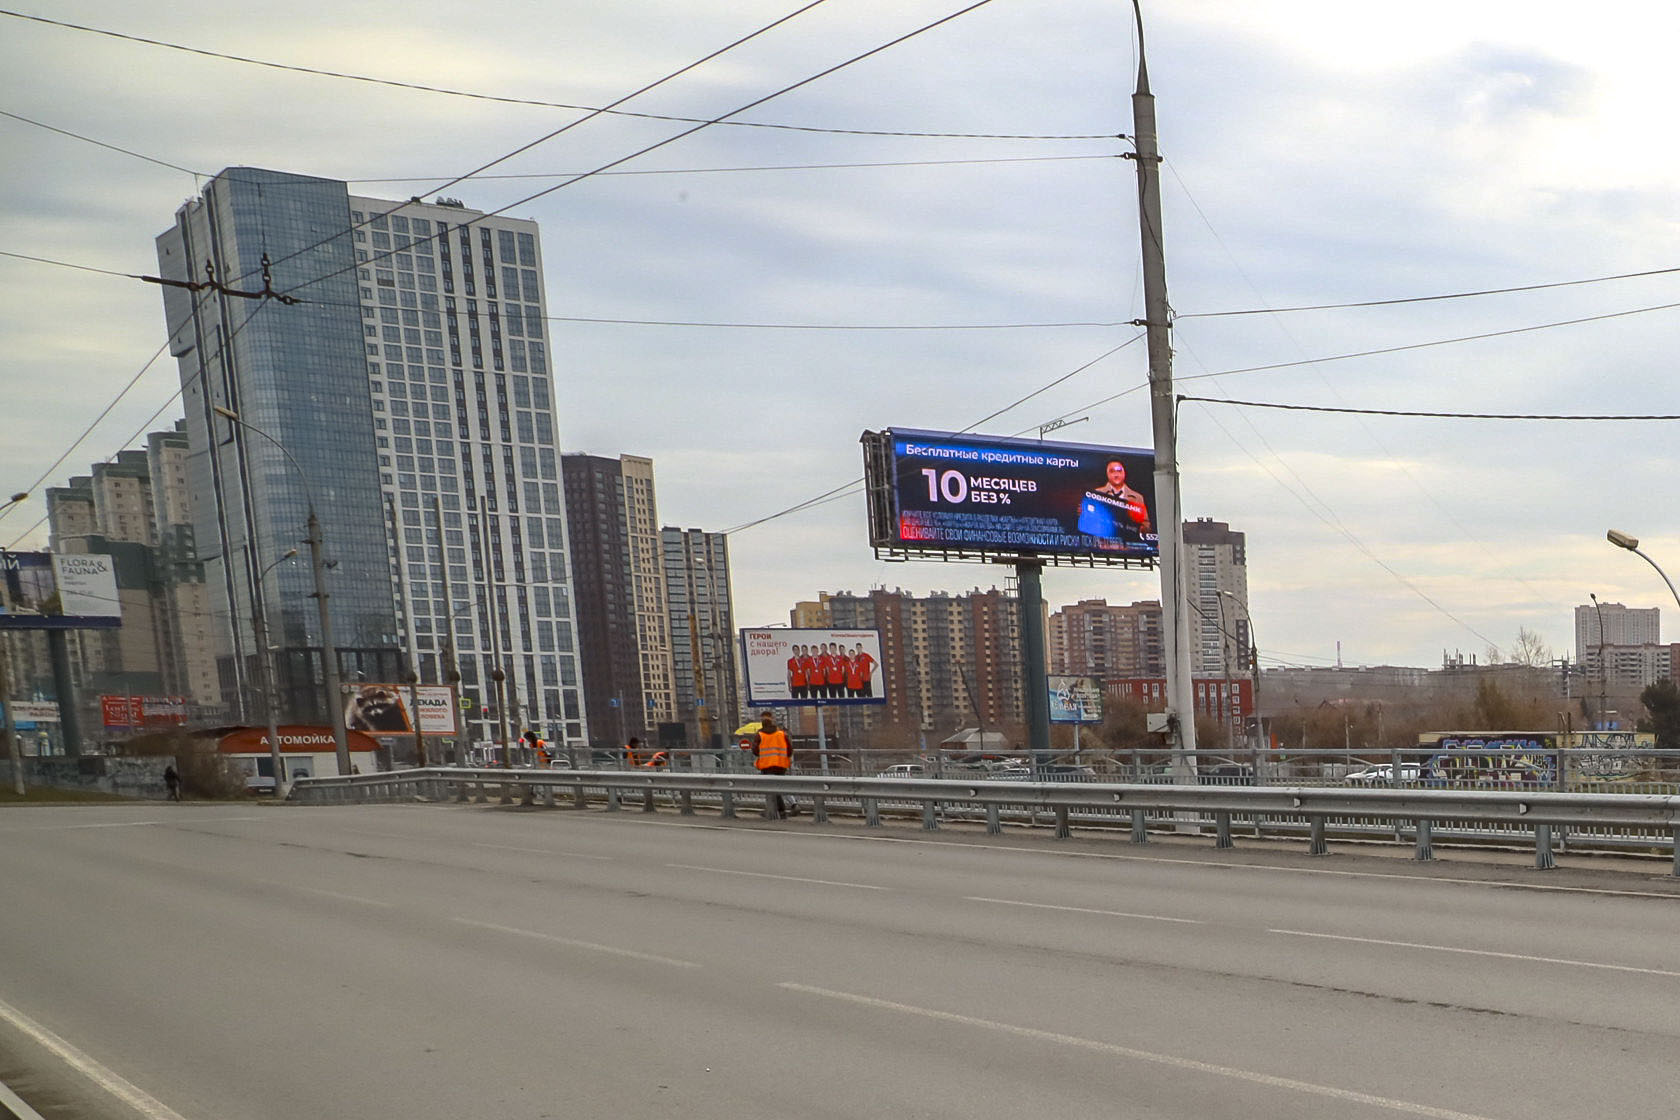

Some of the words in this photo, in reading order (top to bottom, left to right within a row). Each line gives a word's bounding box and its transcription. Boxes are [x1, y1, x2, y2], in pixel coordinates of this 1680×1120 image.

[906, 444, 979, 460] Бесплатные
[981, 451, 1043, 465] кредитные
[1046, 457, 1079, 468] карты
[921, 468, 968, 504] 10
[970, 476, 1037, 493] МЕСЯЦЕВ
[971, 491, 998, 504] БЕЗ
[999, 493, 1011, 505] %
[1085, 491, 1142, 513] СОВКОМБАНК
[902, 526, 944, 540] ОЦЕНИВАЙТЕ
[945, 528, 963, 541] СВОИ
[963, 529, 1007, 543] ФИНАНСОВЫЕ
[1007, 531, 1054, 545] ВОЗМОЖНОСТИ
[60, 558, 95, 567] FLORA
[62, 567, 98, 575] FAUNA
[751, 646, 779, 656] двора!
[260, 733, 336, 745] АТОМОЙКА
